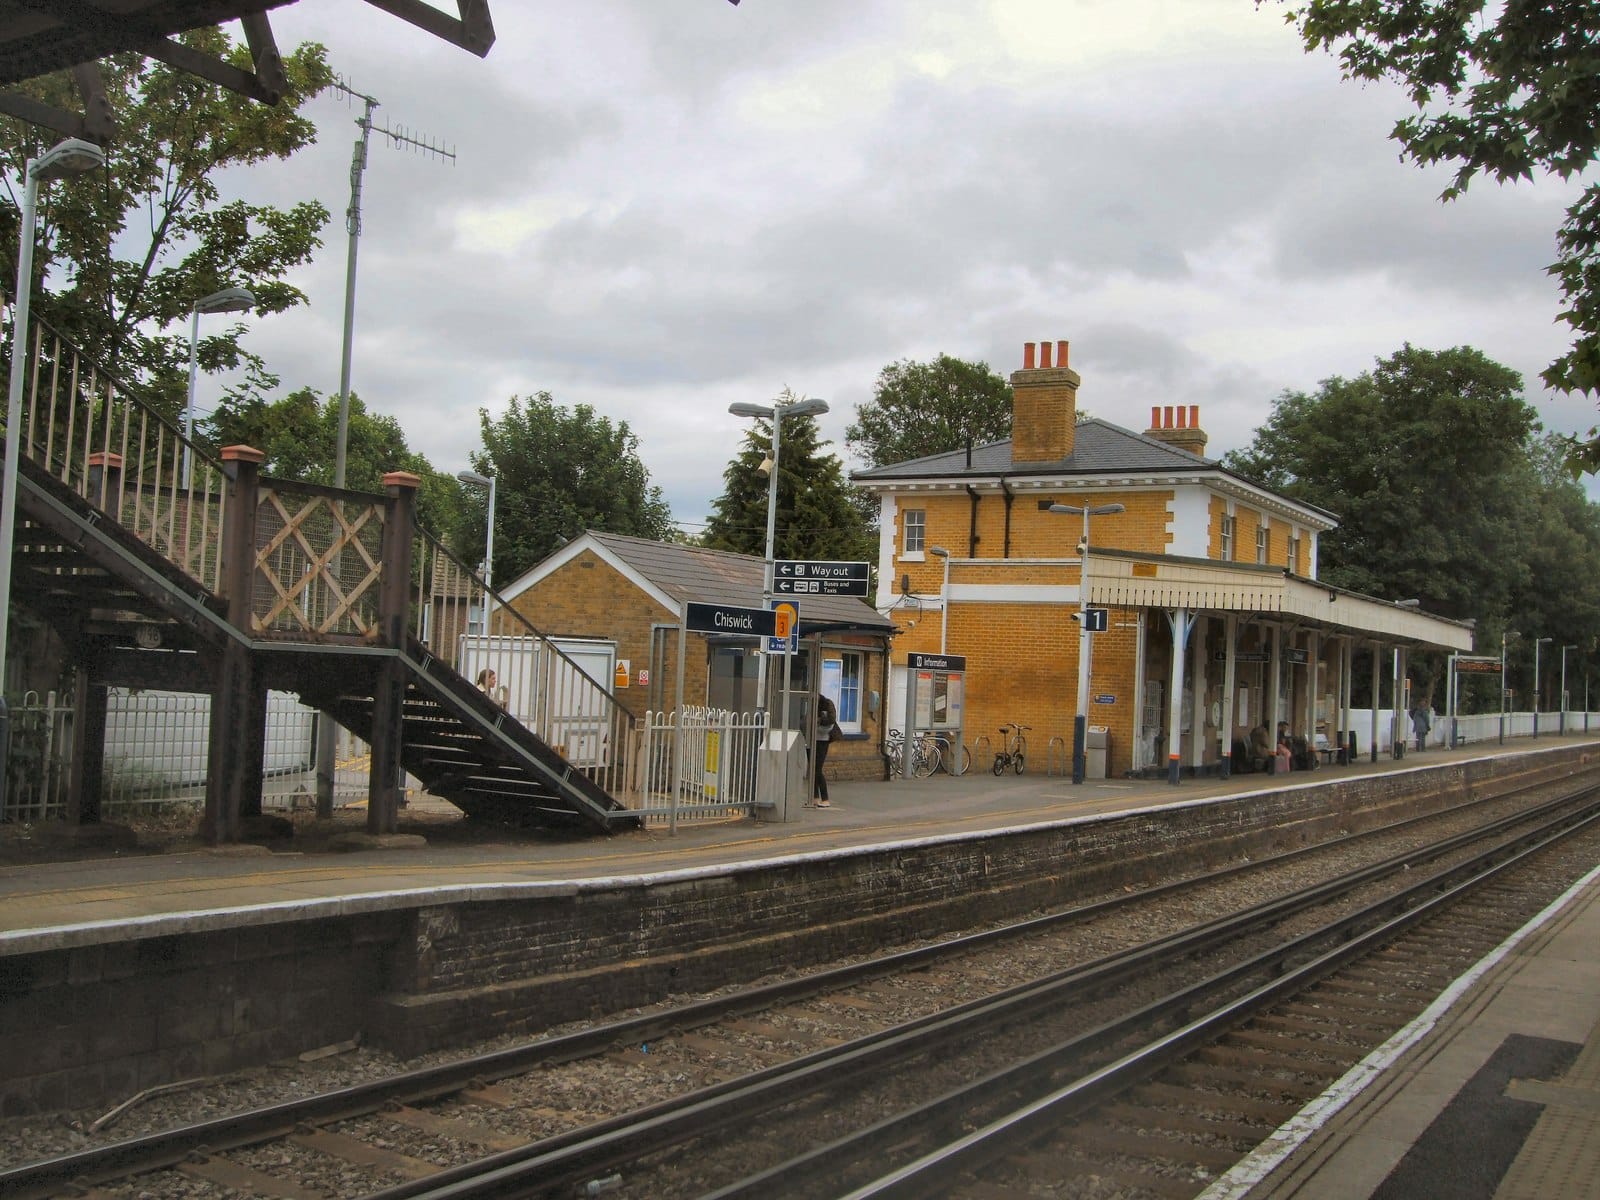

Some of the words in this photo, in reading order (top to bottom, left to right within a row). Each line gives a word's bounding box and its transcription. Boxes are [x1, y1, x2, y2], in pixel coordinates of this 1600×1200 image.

[811, 565, 831, 577] Way
[833, 567, 849, 576] out
[714, 611, 753, 629] Chiswick
[1093, 611, 1100, 630] 1
[924, 657, 948, 668] Information
